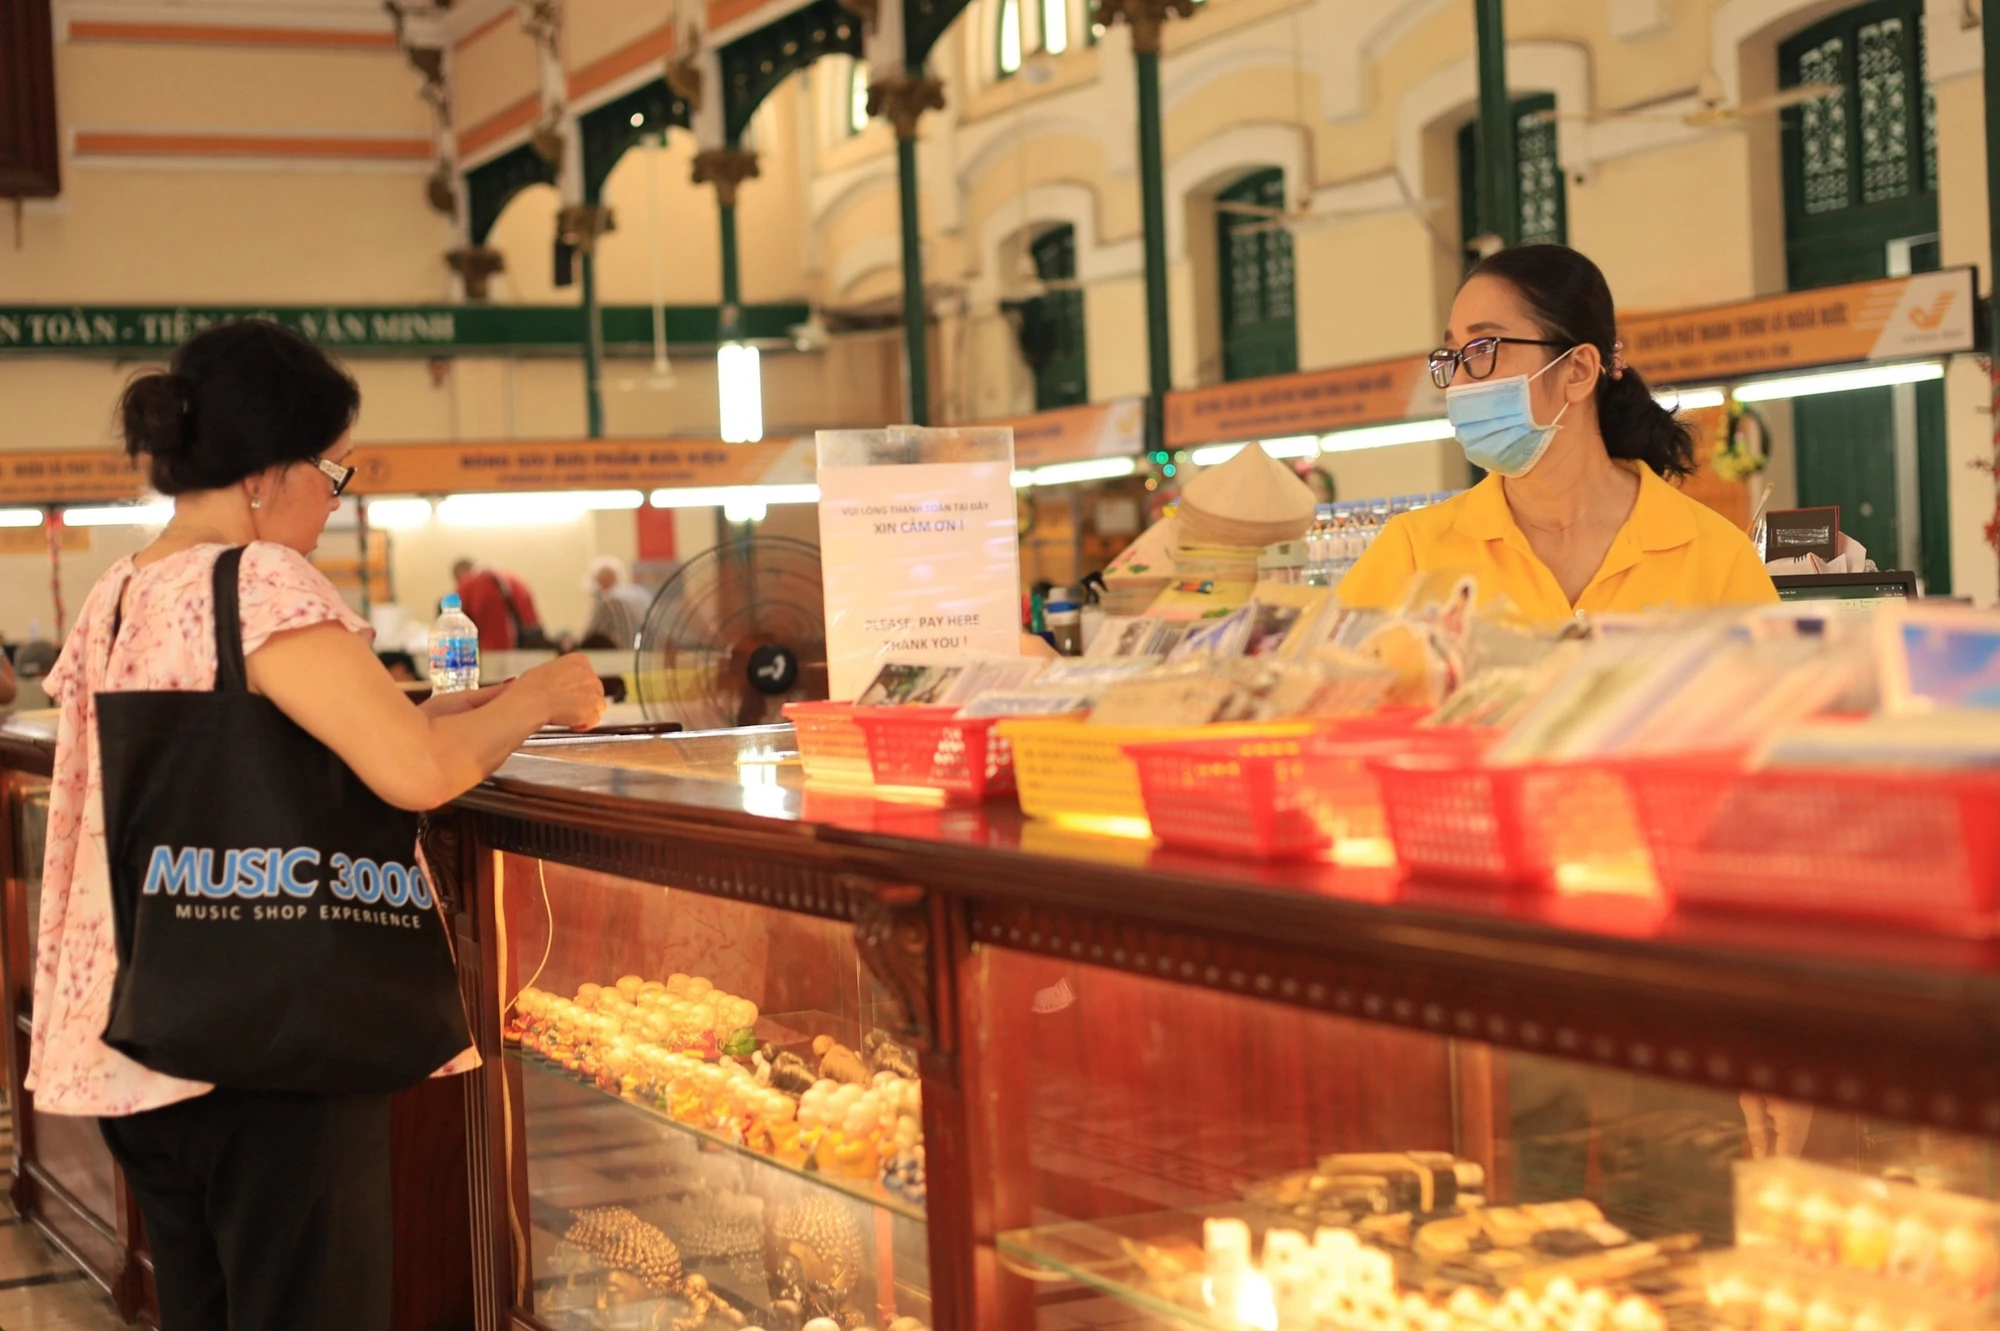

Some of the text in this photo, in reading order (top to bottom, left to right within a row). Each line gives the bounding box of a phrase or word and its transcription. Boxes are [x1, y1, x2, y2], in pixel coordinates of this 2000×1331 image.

[874, 522, 897, 534] XIN
[919, 616, 943, 628] PAY
[947, 614, 980, 626] HERE
[884, 637, 928, 651] THANK
[932, 636, 959, 649] YOU
[143, 845, 434, 911] MUSIC 3000
[175, 904, 422, 929] MUSIC SHOP EXPERIENCE
